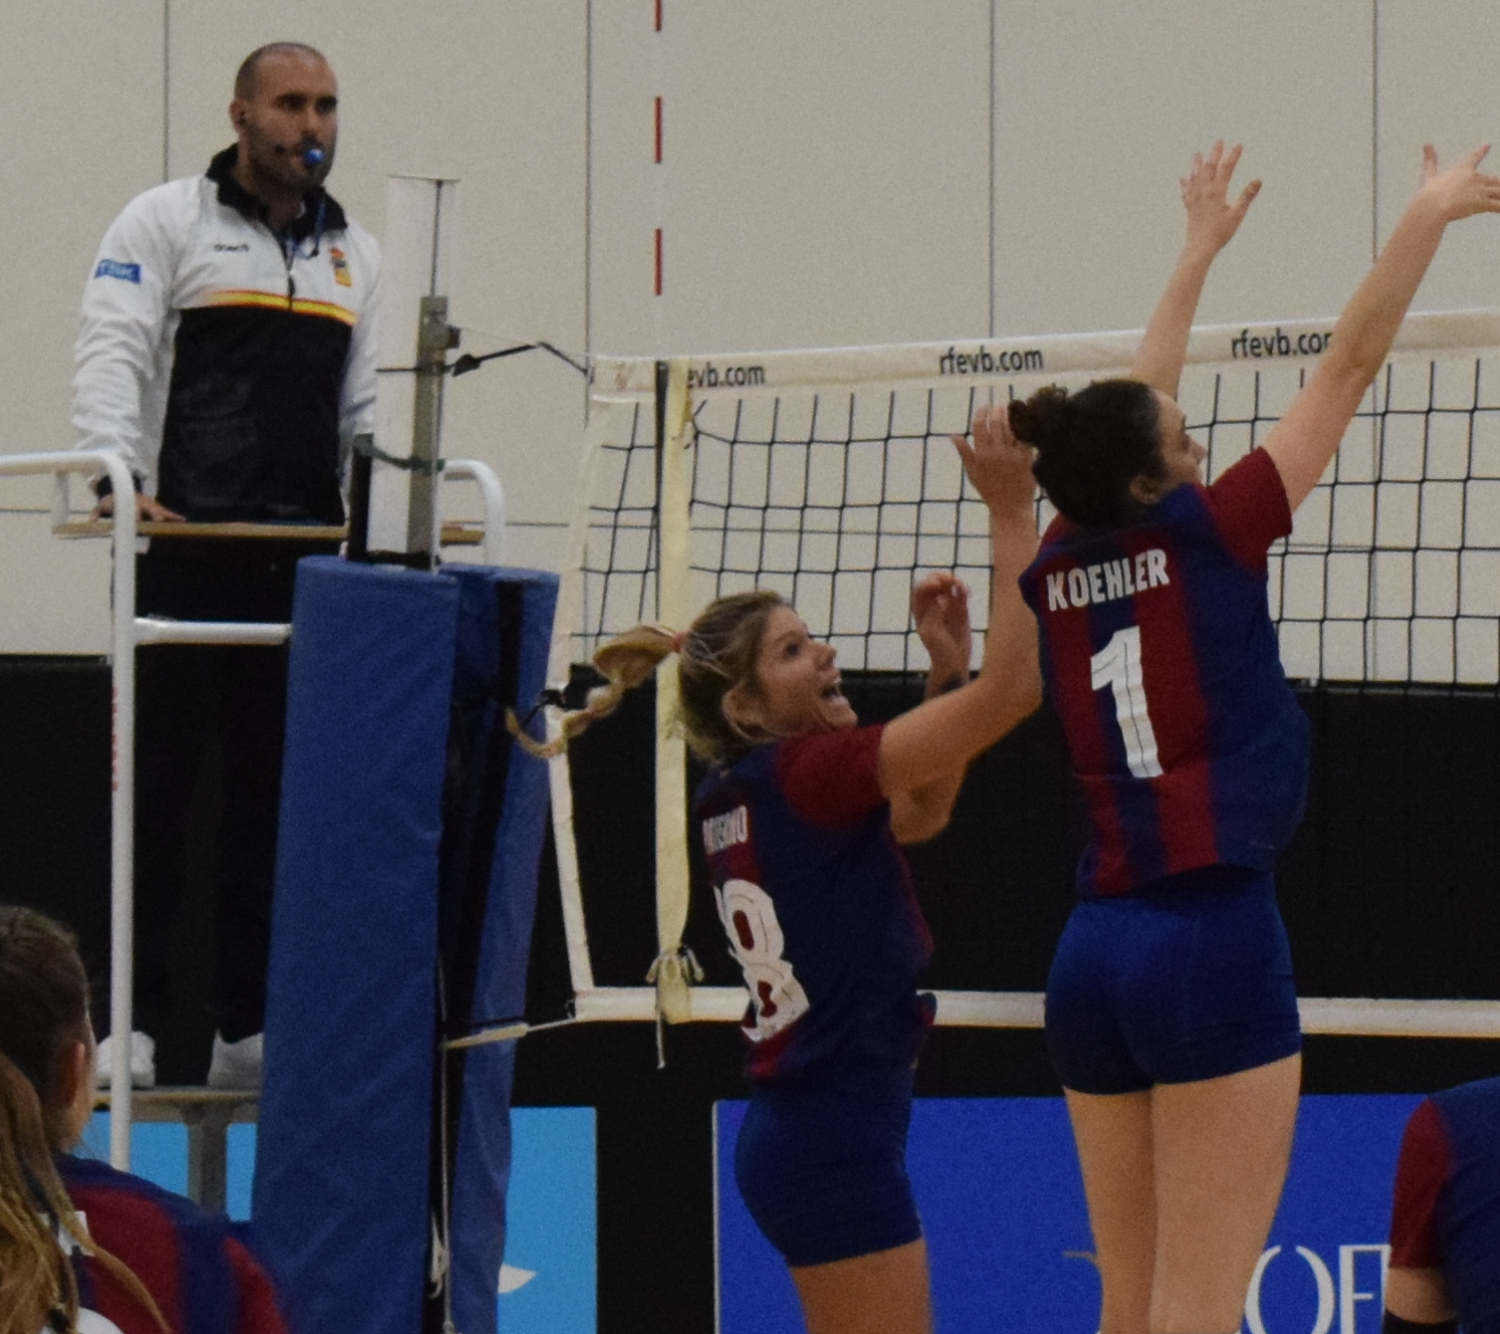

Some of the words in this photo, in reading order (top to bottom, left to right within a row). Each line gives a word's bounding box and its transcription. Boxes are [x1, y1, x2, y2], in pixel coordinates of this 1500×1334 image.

[687, 361, 766, 388] evb.com
[938, 345, 1044, 375] rfevb.com
[1046, 548, 1170, 611] KOEHLER
[1090, 625, 1164, 779] 1
